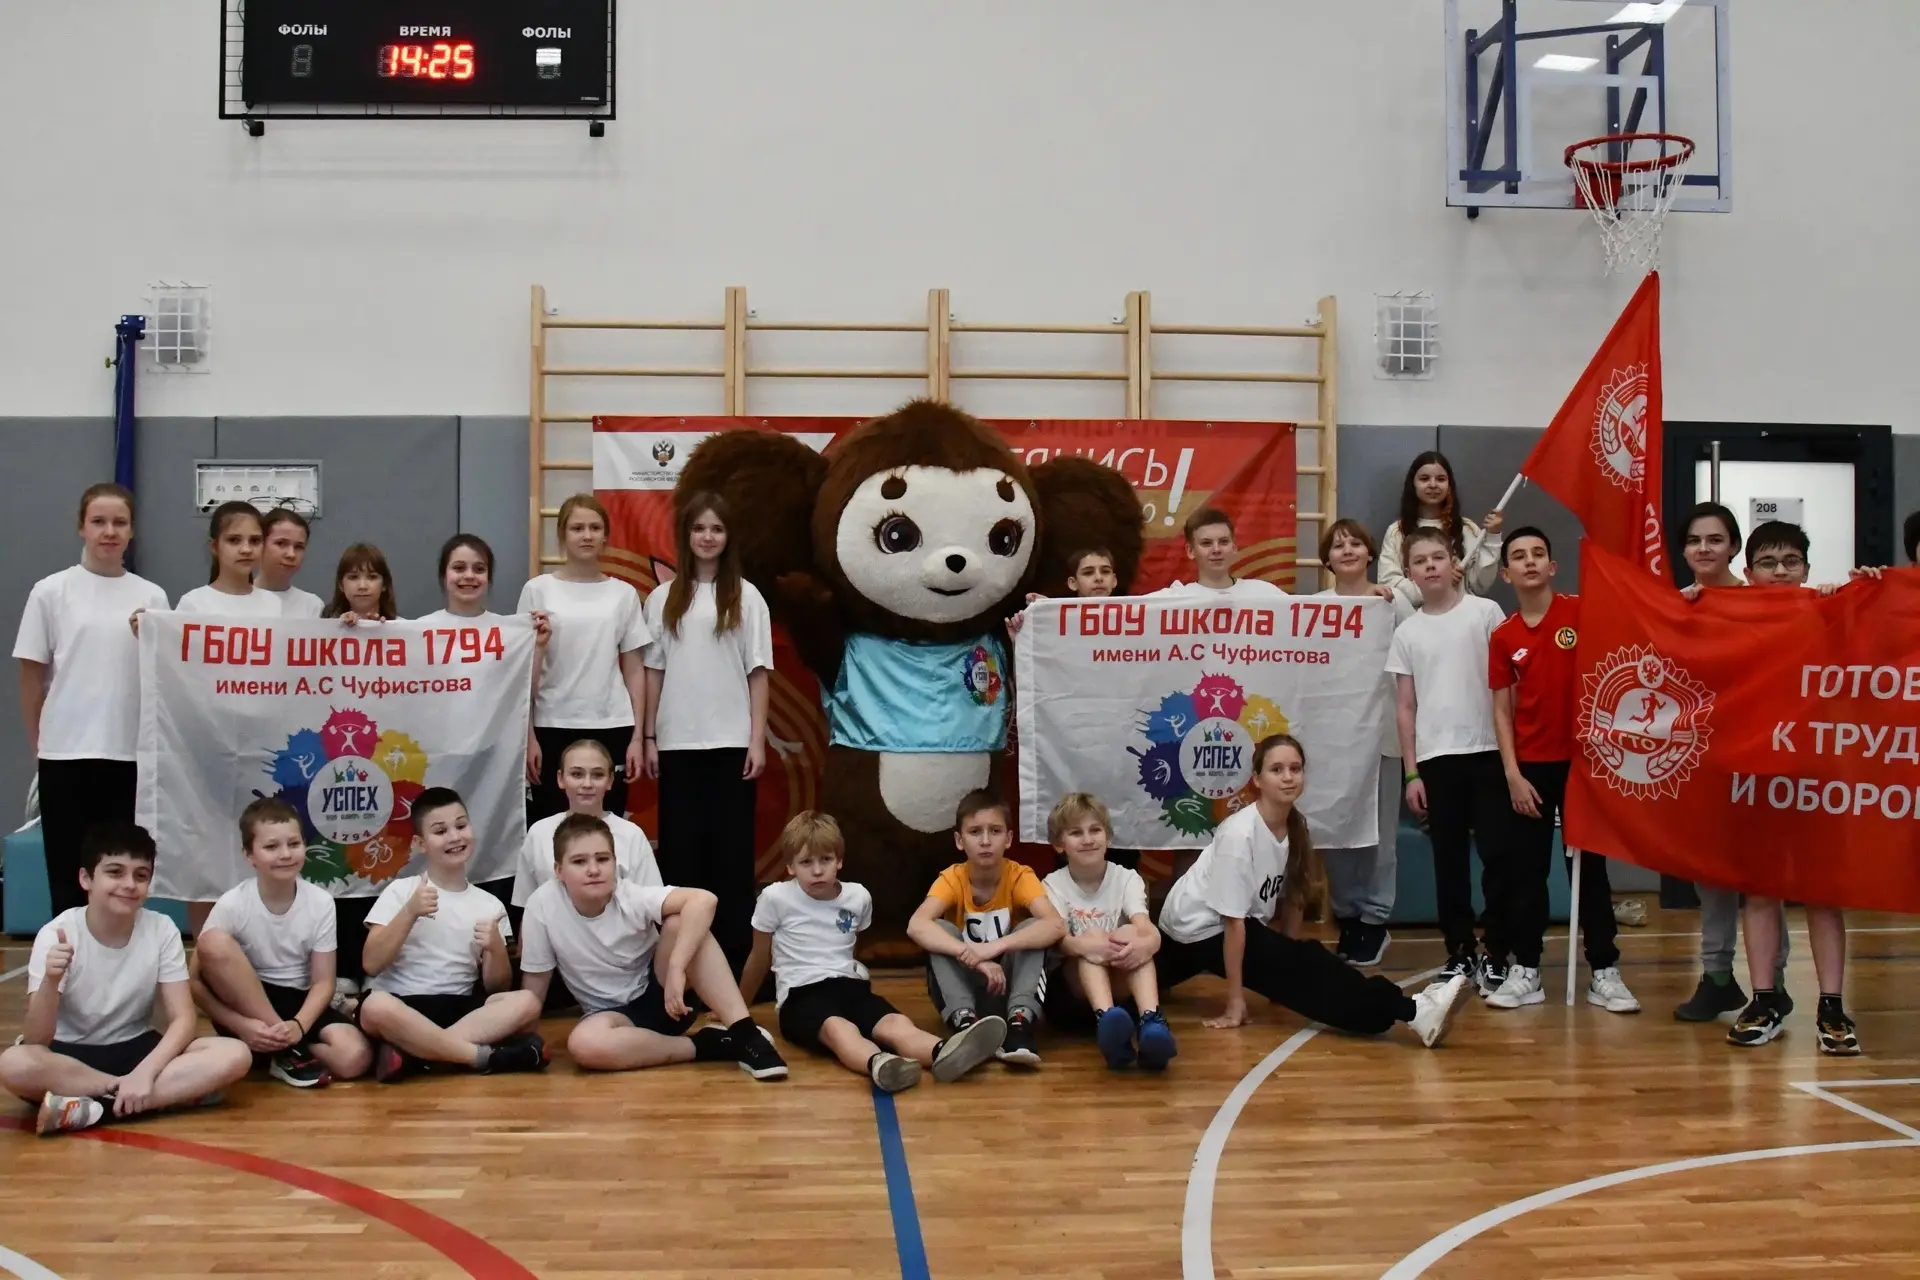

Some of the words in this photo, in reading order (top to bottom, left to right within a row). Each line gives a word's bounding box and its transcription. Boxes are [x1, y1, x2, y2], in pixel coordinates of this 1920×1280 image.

[278, 24, 328, 36] ФОЛЫ
[399, 26, 452, 37] ВРЕМЯ
[521, 27, 572, 39] ФОЛЫ
[388, 44, 474, 79] 14:25
[1756, 503, 1777, 513] 208
[1059, 603, 1146, 636] ГБОУ
[1290, 603, 1364, 638] 1794
[181, 623, 272, 667] ГБОУ
[422, 626, 505, 665] 1794
[1092, 649, 1161, 662] имени
[1167, 643, 1206, 662] А.С
[1212, 643, 1330, 665] Чуфистова
[216, 678, 288, 695] имени
[294, 677, 334, 696] А.С
[341, 675, 472, 699] Чуфистова
[1800, 665, 1920, 701] ГОТОВ
[1617, 733, 1656, 751] ГТО
[1772, 721, 1797, 753] К
[1808, 721, 1920, 765] ТРУД
[1192, 745, 1243, 770] УСПЕХ
[321, 785, 379, 813] УСПЕХ
[1200, 786, 1234, 797] 1794
[1731, 772, 1756, 805] И
[1767, 776, 1920, 820] ОБОРО
[331, 829, 371, 842] 1794
